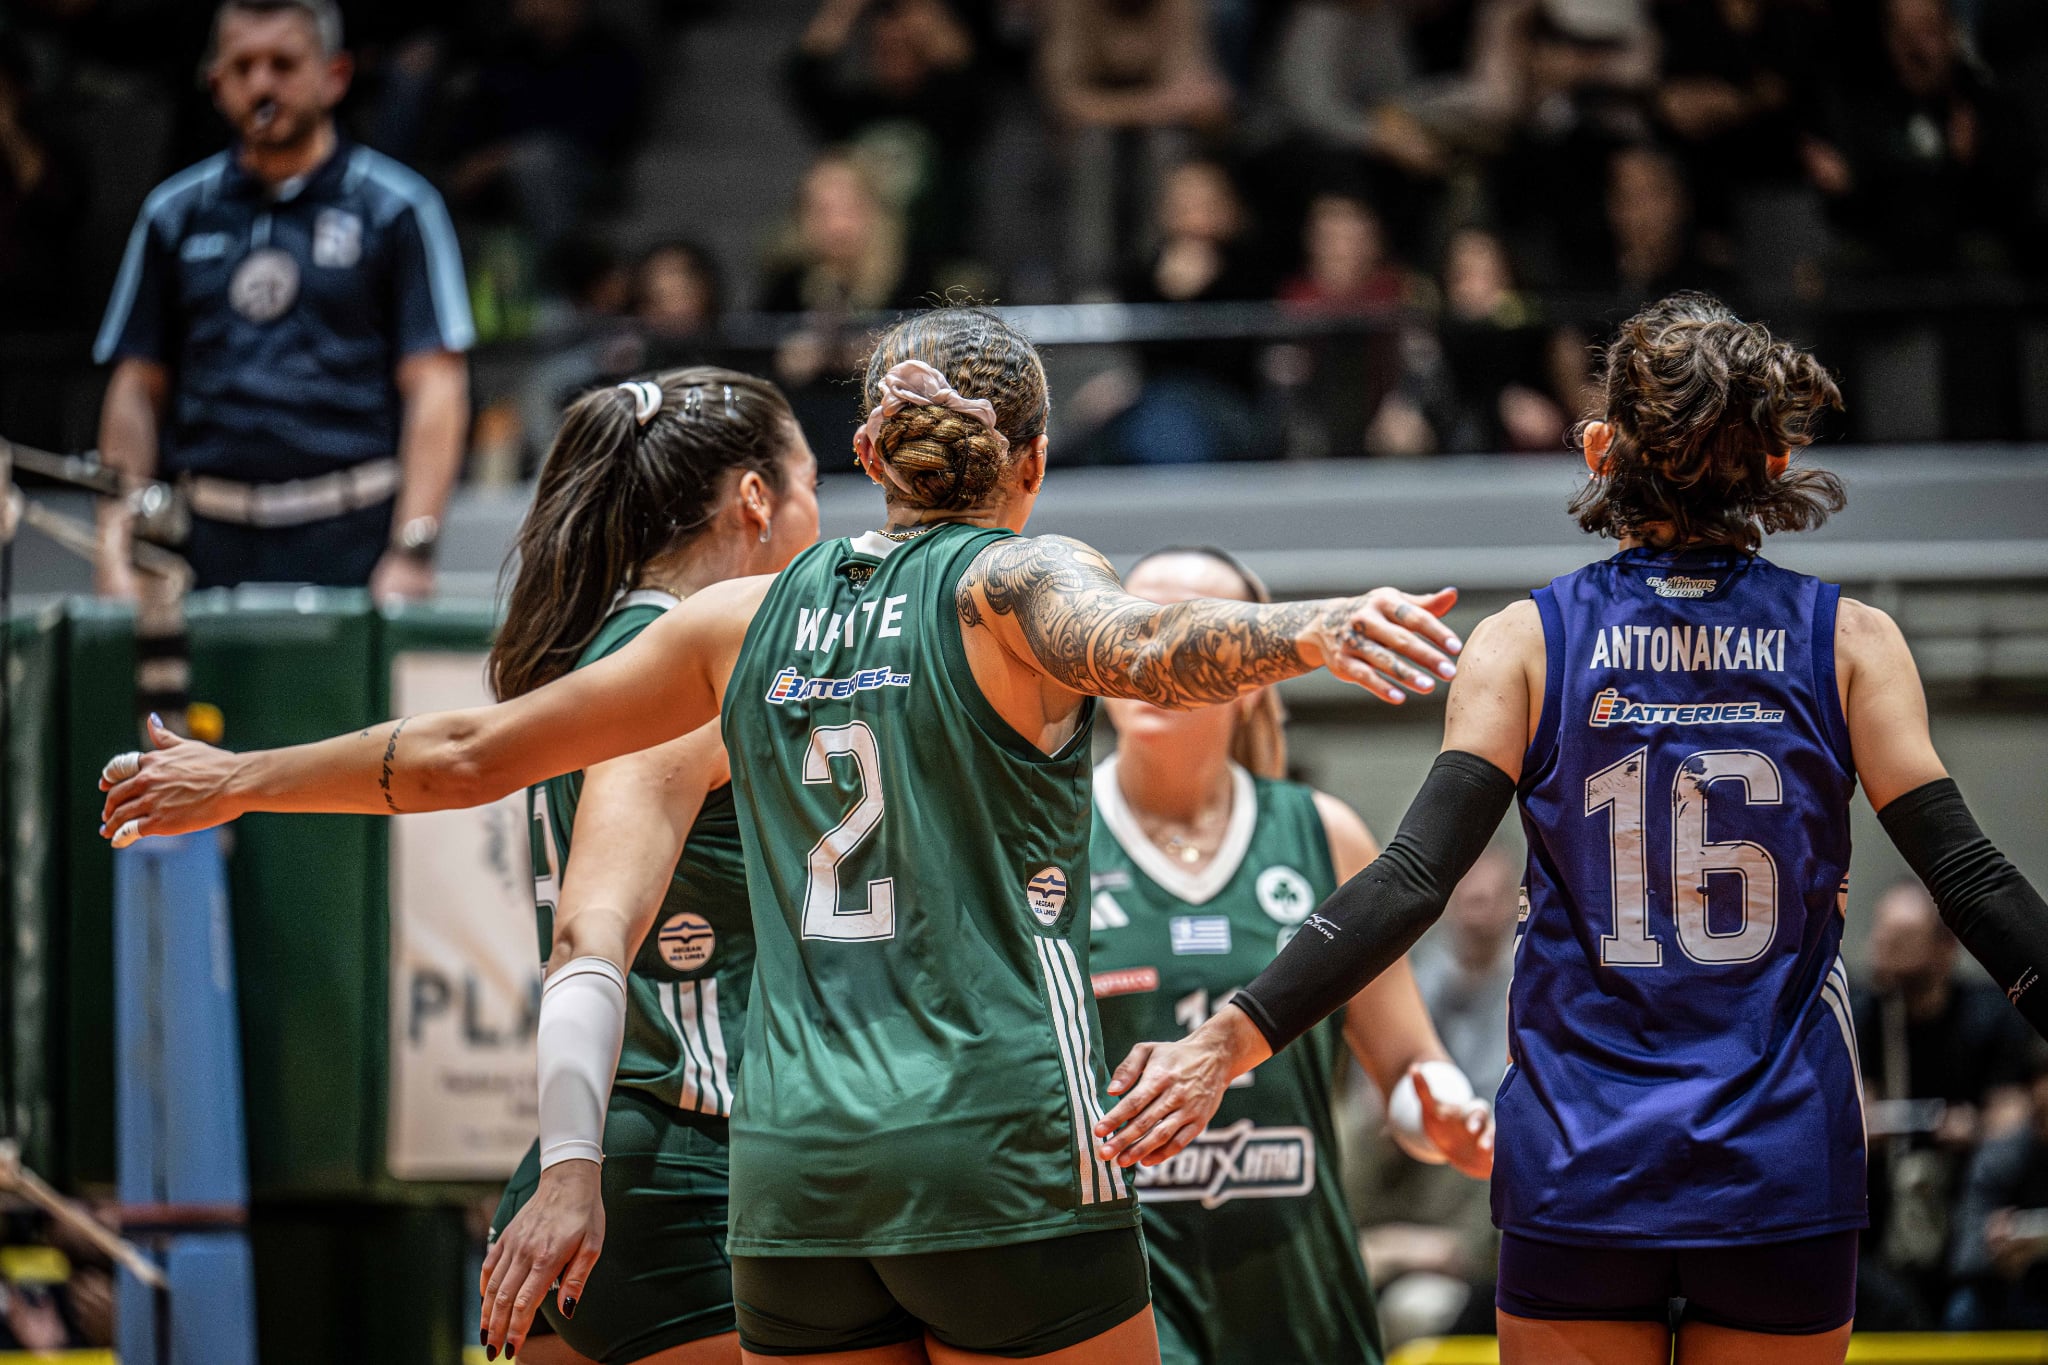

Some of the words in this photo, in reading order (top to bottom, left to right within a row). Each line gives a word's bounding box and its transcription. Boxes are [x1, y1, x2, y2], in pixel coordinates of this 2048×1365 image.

[1589, 625, 1785, 672] ANTONAKAKI
[1605, 699, 1783, 723] BATTERIES.GR
[802, 720, 894, 942] 2
[1584, 745, 1782, 968] 16
